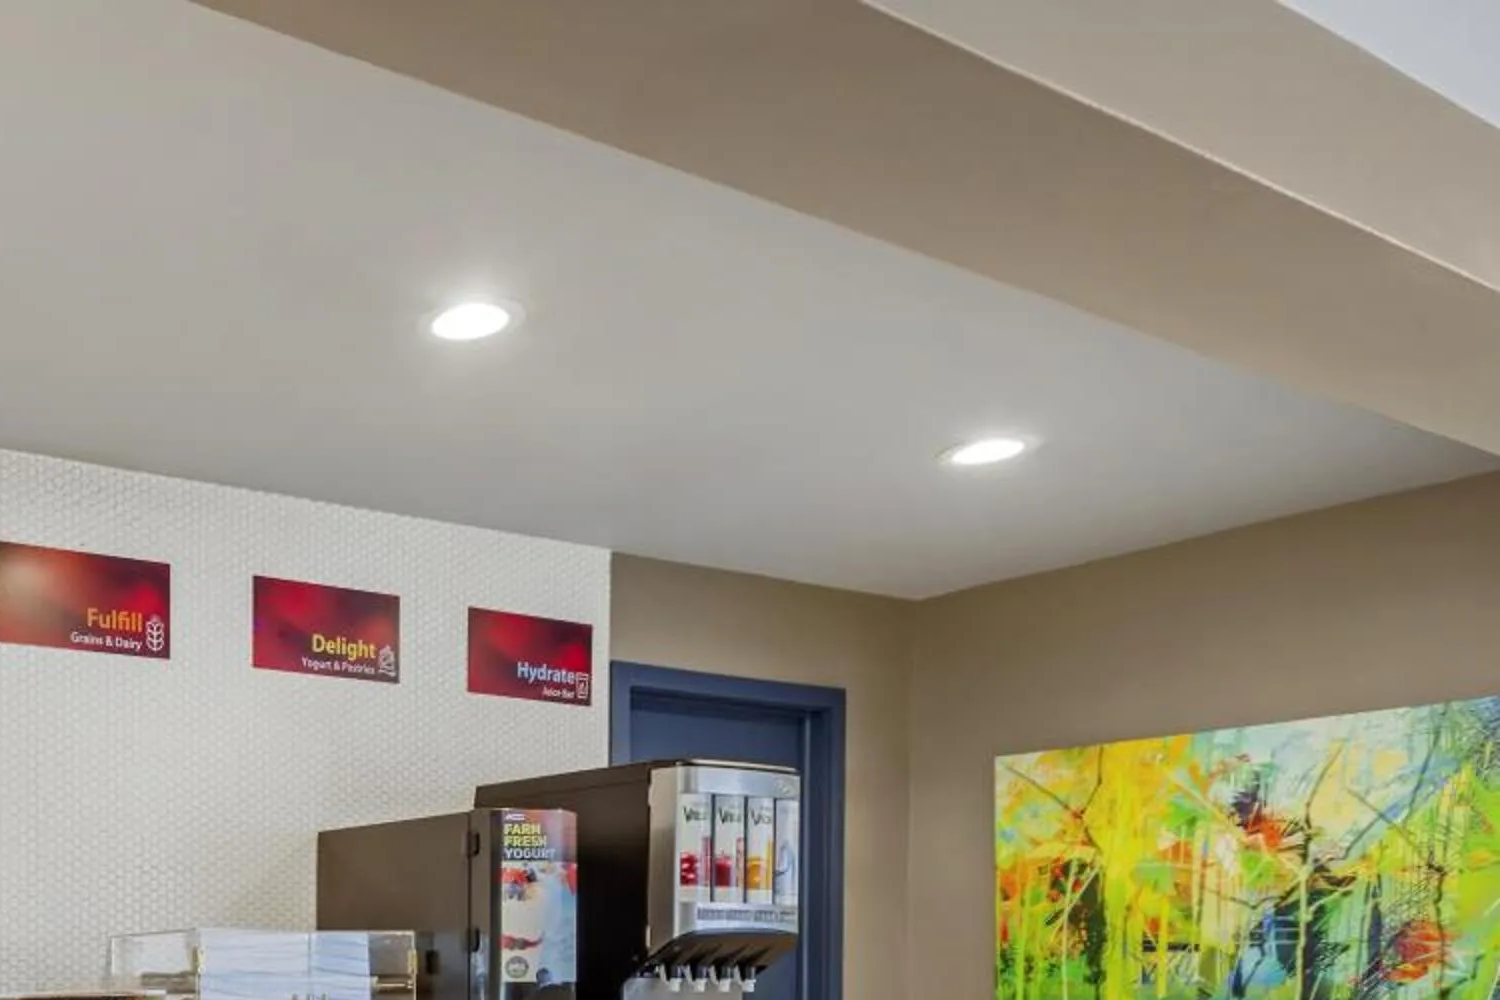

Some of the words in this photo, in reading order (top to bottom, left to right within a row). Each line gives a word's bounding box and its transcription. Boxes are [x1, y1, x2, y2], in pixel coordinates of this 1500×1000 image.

[86, 607, 142, 632] Fulfill
[70, 631, 103, 645] Grains
[115, 636, 142, 651] Dairy
[312, 633, 376, 660] Delight
[301, 656, 331, 671] Yogurt
[517, 661, 575, 684] Hydrate
[503, 823, 541, 835] FARM
[503, 835, 547, 847] FRESH
[504, 847, 556, 859] YOGURT
